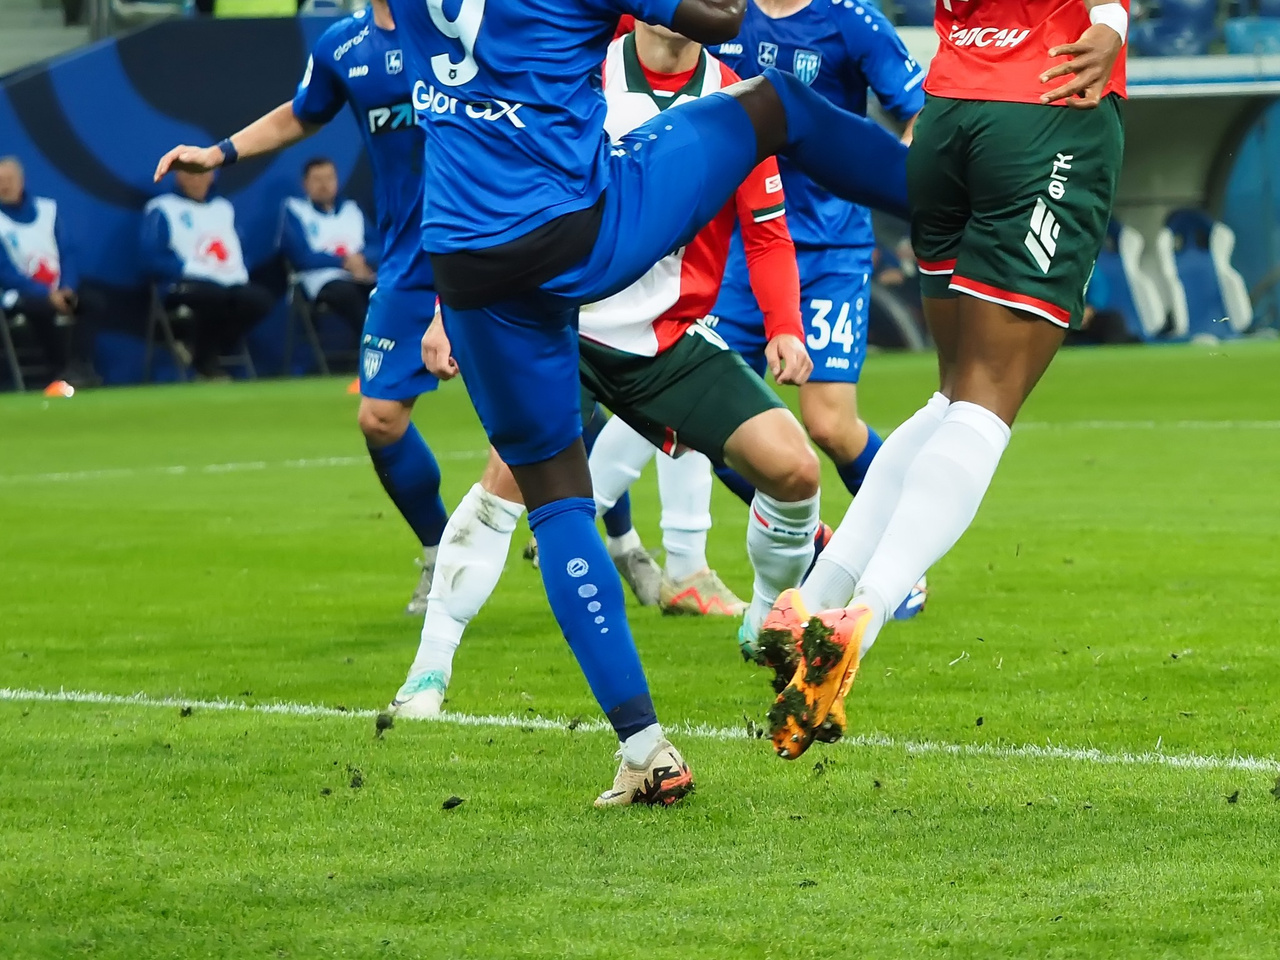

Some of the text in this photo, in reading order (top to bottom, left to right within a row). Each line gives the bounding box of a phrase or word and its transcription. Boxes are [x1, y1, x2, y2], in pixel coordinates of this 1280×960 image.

[368, 102, 417, 134] PA
[1048, 152, 1074, 200] ФГК
[806, 299, 855, 354] 34
